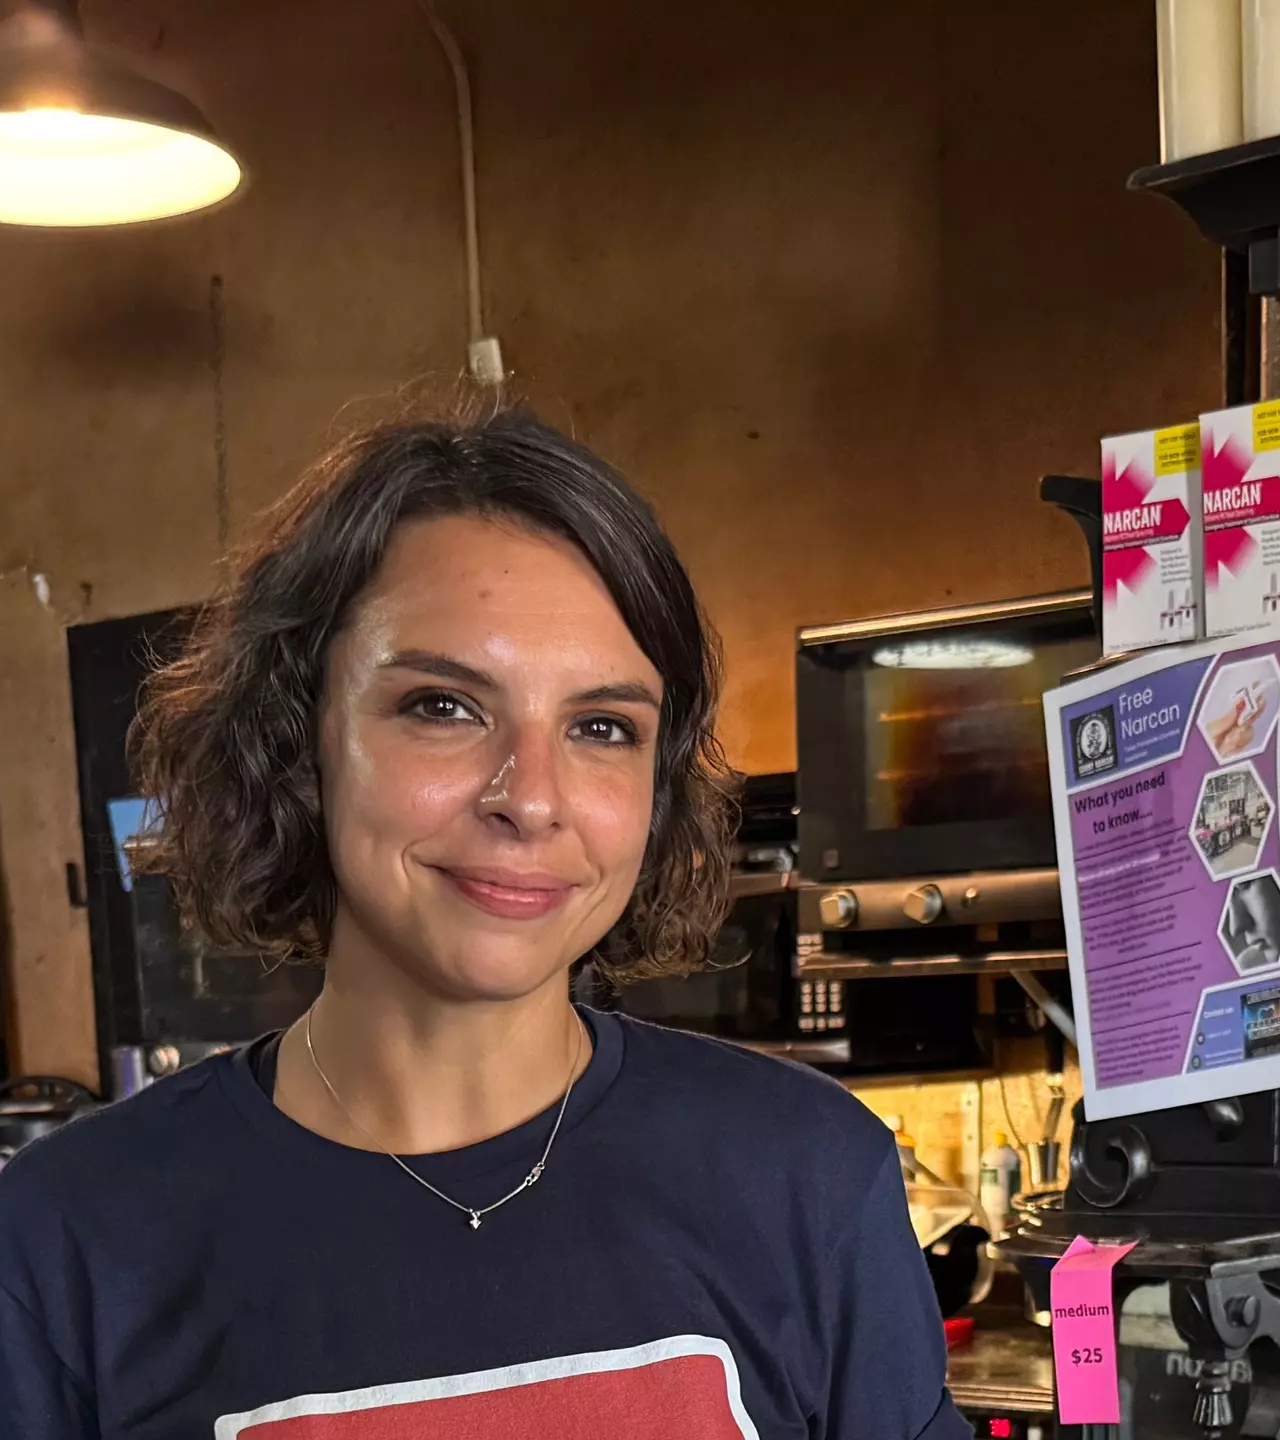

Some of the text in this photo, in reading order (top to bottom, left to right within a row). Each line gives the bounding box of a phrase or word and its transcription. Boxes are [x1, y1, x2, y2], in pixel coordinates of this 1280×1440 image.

[1203, 483, 1260, 514] NARCAN
[1103, 505, 1161, 534] NARCAN
[1119, 688, 1152, 714] Free
[1121, 705, 1179, 740] Narcan
[1075, 772, 1165, 813] What you need
[1093, 821, 1105, 834] to
[1055, 1305, 1109, 1319] medium
[1071, 1348, 1103, 1366] $25
